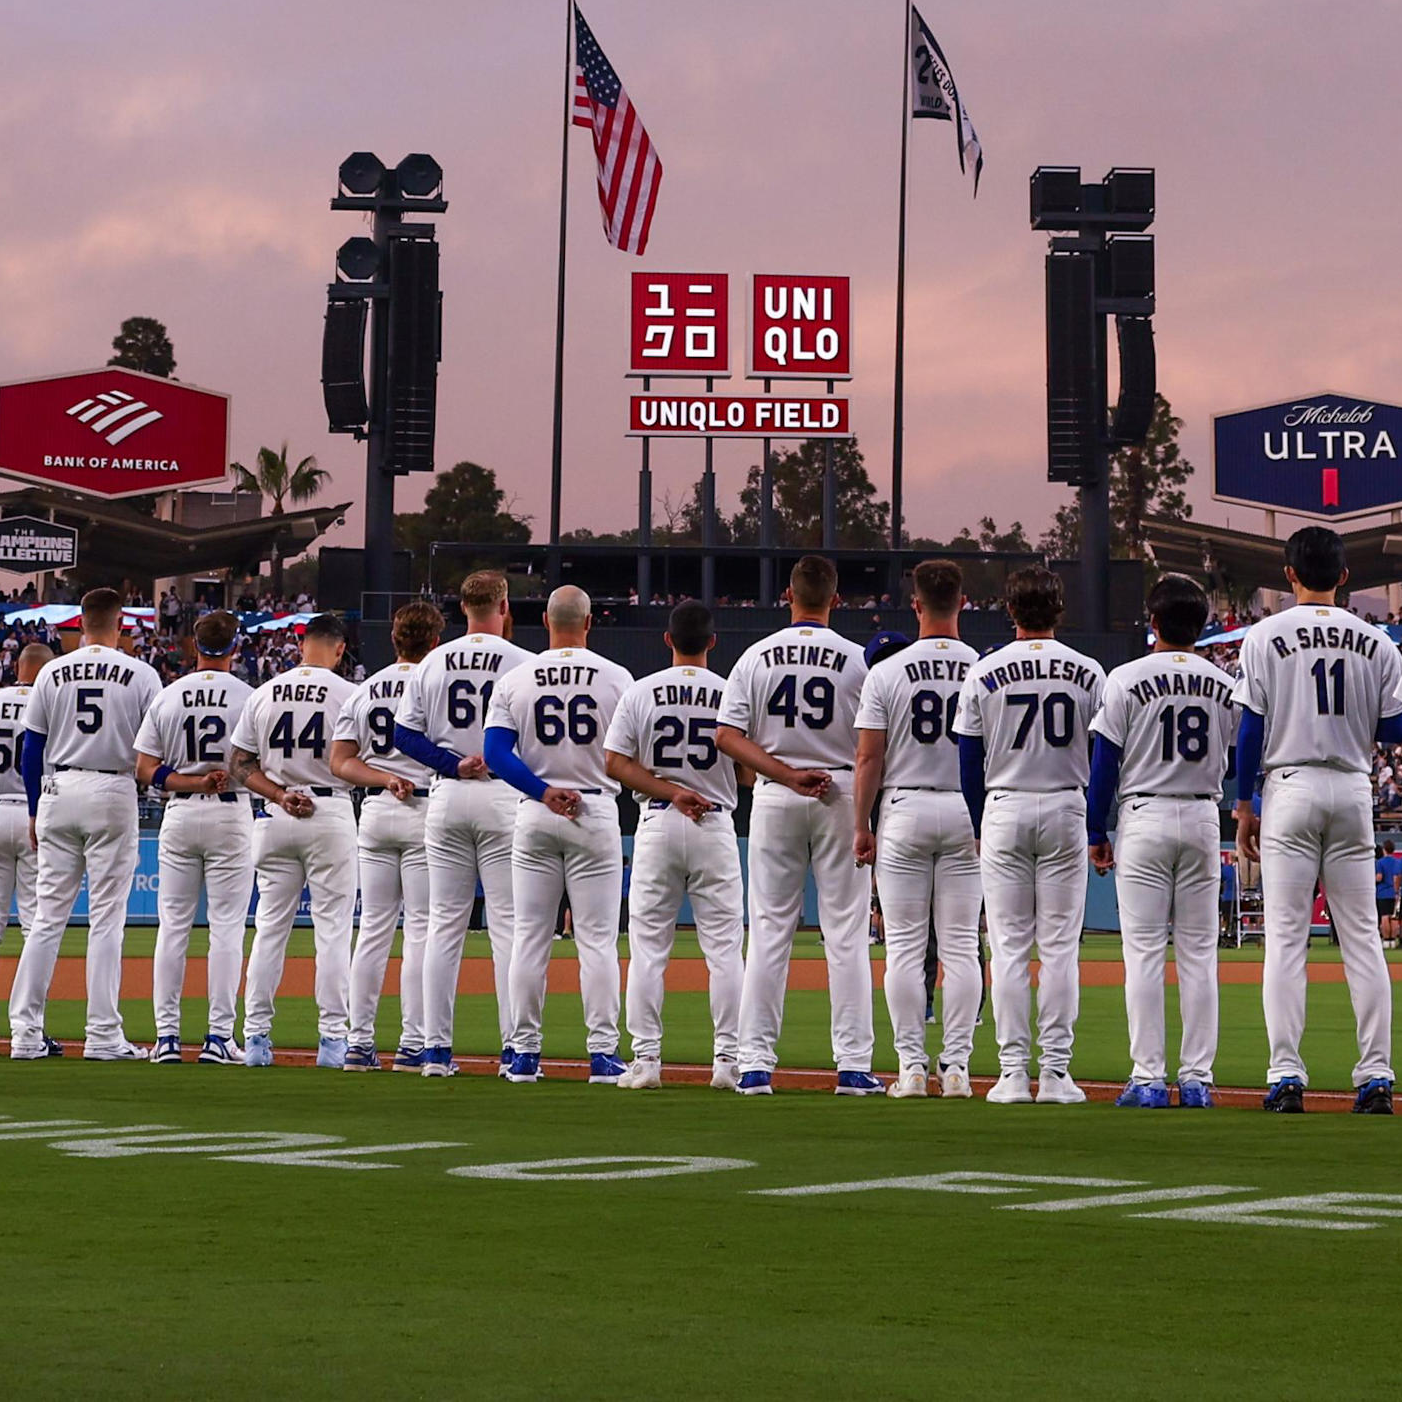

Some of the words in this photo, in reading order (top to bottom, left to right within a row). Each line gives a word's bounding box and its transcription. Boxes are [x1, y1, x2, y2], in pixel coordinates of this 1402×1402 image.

[764, 286, 832, 320] UNI
[764, 326, 839, 365] QLO
[640, 400, 745, 431] UNIQLO
[755, 402, 840, 428] FIELD
[1283, 404, 1373, 427] Michelob
[1264, 430, 1398, 461] ULTRA
[44, 455, 85, 468] BANK
[89, 458, 107, 469] OF
[111, 458, 179, 471] AMERICA
[14, 528, 35, 536] THE
[52, 663, 135, 687] FREEMAN
[445, 651, 503, 674] KLEIN
[761, 645, 848, 673] TREINEN
[534, 666, 599, 687] SCOTT
[980, 659, 1098, 695] WROBLESKI
[1310, 657, 1346, 716] 11
[76, 688, 104, 734] 5
[182, 689, 228, 709] CALL
[272, 684, 328, 704] PAGES
[448, 679, 494, 729] 61
[653, 685, 723, 710] EDMAN
[767, 674, 835, 730] 49
[268, 710, 326, 759] 44
[534, 694, 598, 746] 66
[1007, 692, 1075, 750] 70
[1159, 704, 1209, 762] 18
[183, 715, 226, 763] 12
[653, 715, 718, 770] 25
